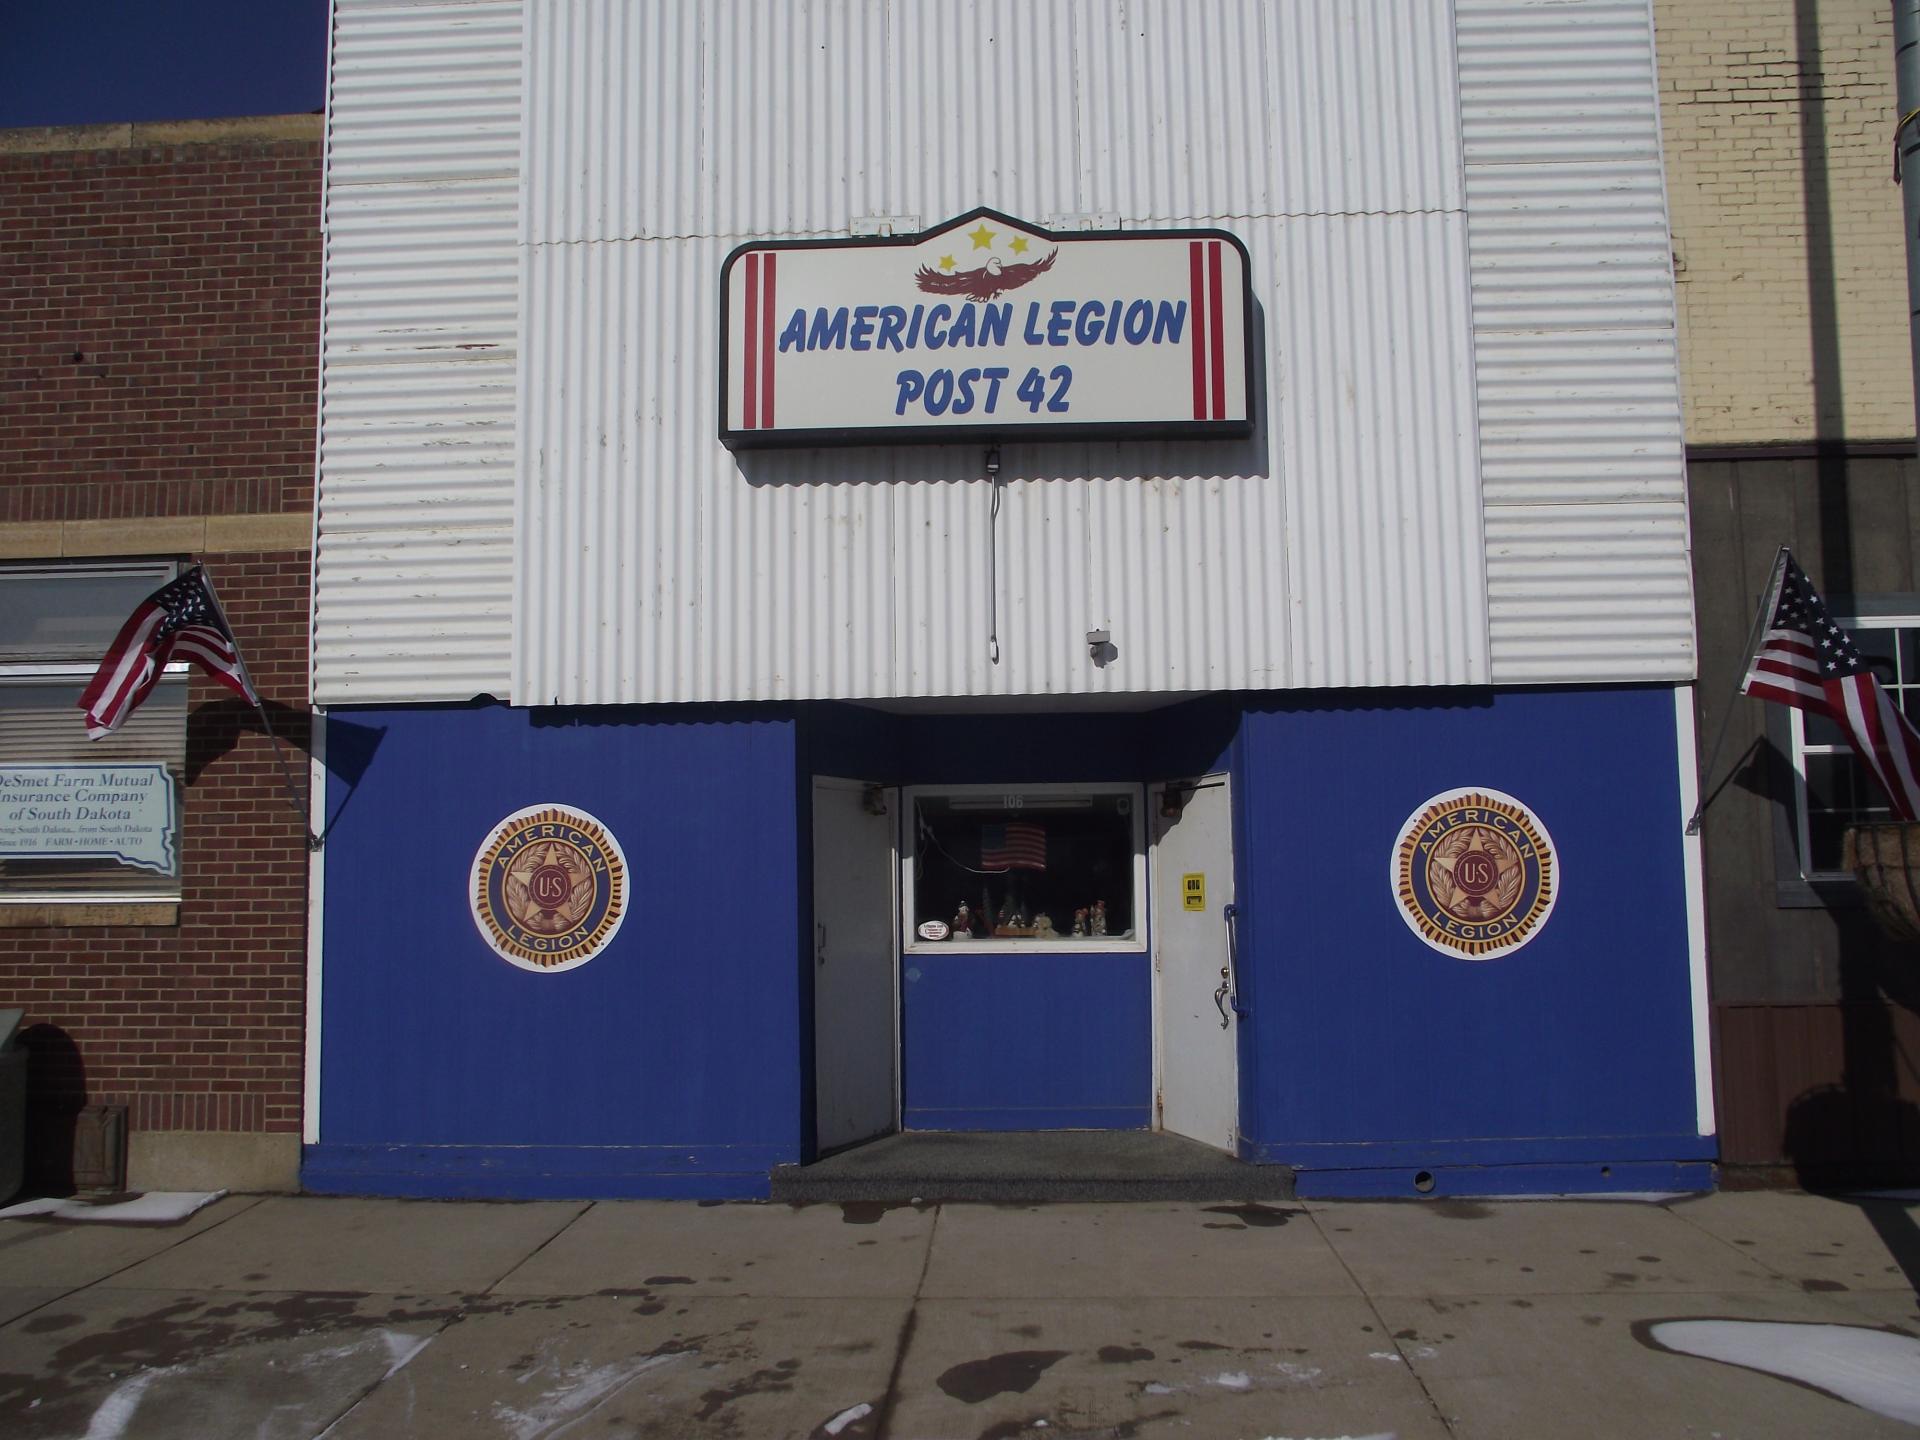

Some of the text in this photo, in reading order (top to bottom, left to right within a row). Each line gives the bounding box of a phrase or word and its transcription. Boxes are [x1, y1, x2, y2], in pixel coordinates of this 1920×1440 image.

[778, 299, 1187, 354] AMERICAN LEGION
[895, 365, 1073, 417] POST 42
[53, 774, 94, 787] Farm
[97, 774, 155, 787] Mutual
[74, 789, 148, 804] Company
[1003, 794, 1024, 809] 106
[9, 806, 131, 821] of South Dakota
[1420, 810, 1534, 860] AMERICAN
[498, 825, 606, 873] AMERICAN
[507, 924, 589, 950] LEGION
[1431, 912, 1518, 938] LEGION
